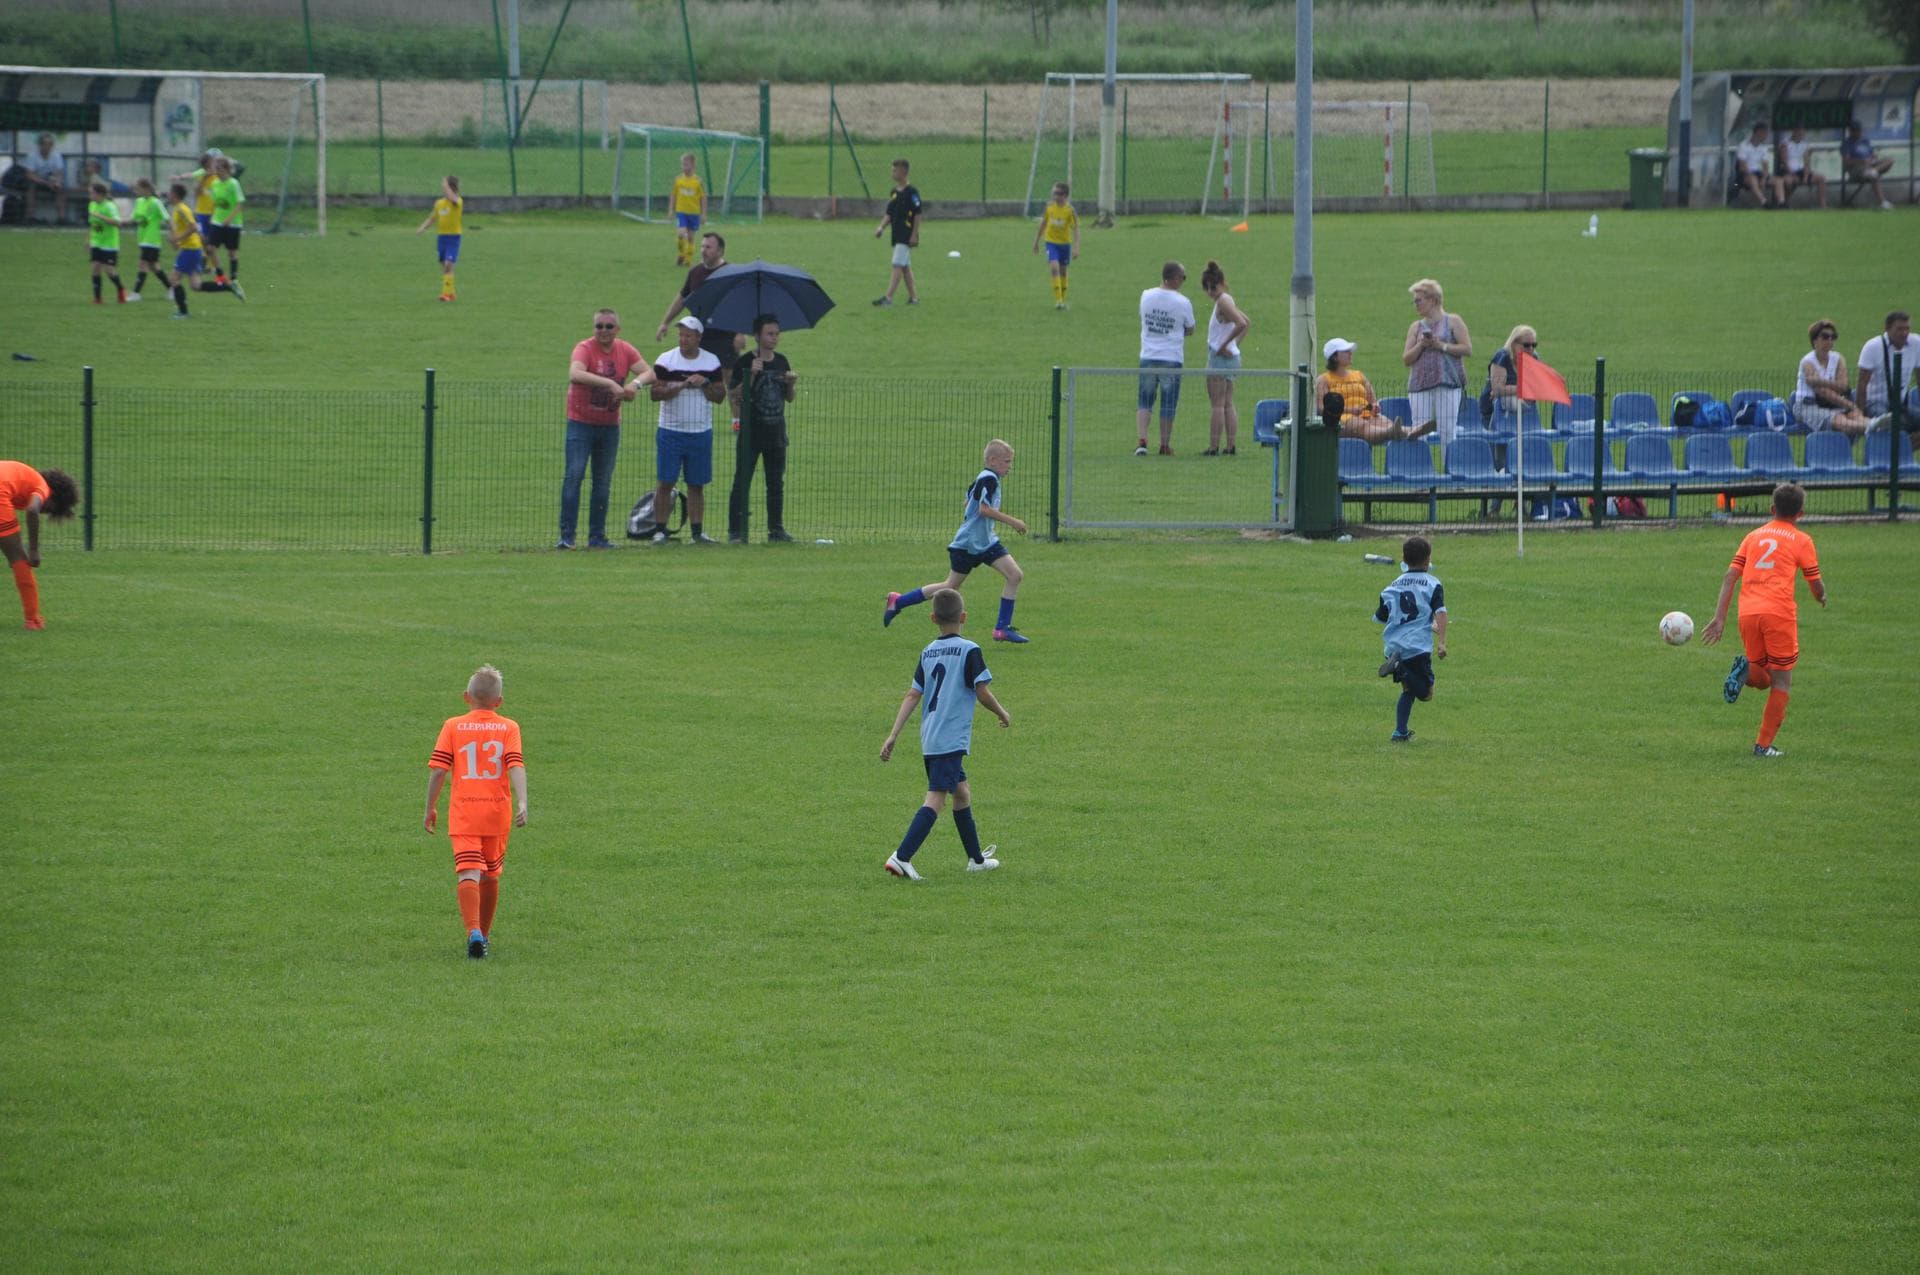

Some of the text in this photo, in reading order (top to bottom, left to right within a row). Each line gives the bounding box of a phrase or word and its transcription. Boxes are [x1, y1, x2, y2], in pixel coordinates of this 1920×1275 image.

[1754, 537, 1778, 570] 2
[1399, 590, 1419, 625] 9
[928, 662, 946, 713] 7
[456, 722, 508, 731] CLEPARDIA
[458, 739, 504, 780] 13
